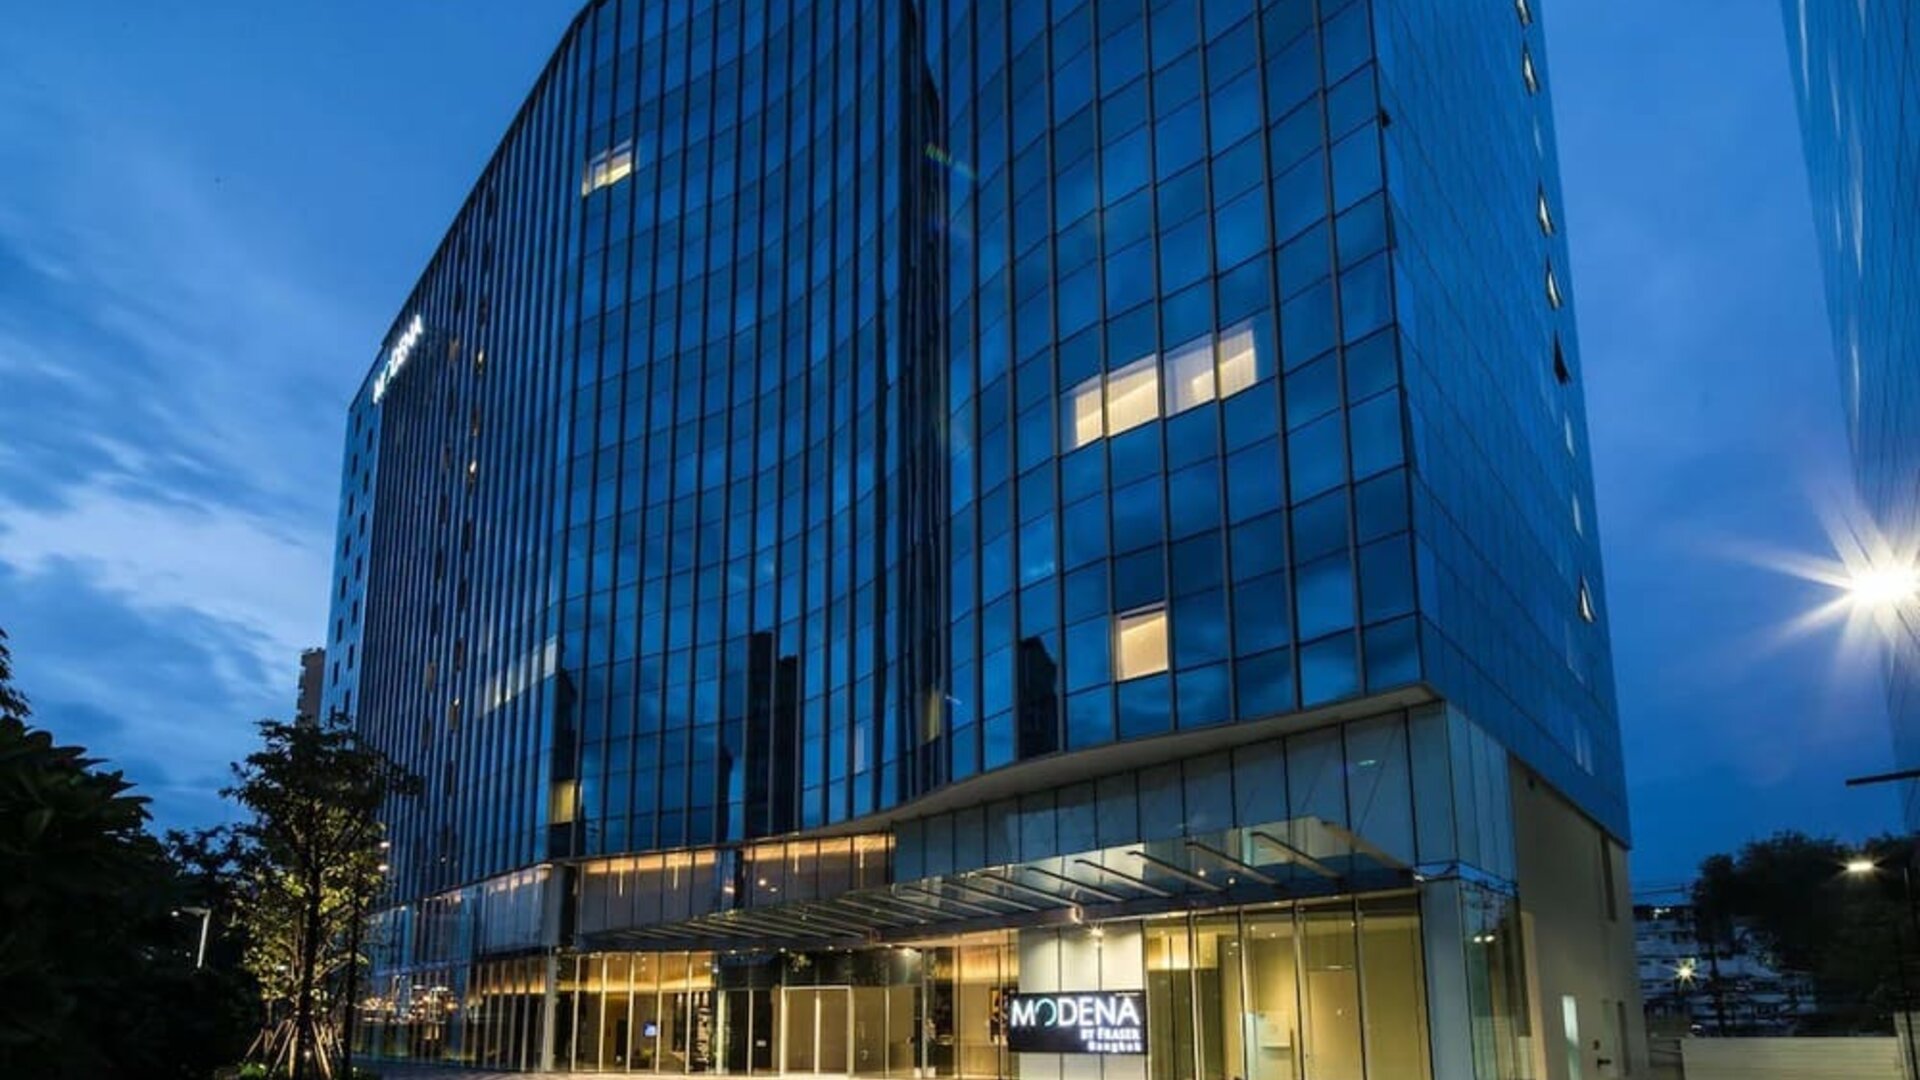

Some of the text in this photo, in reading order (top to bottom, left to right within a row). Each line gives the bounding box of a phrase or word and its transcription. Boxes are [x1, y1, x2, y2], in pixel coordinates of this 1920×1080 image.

[1011, 994, 1140, 1026] MODENA
[1096, 1027, 1140, 1040] FRASER
[1087, 1040, 1142, 1053] Bangkok
